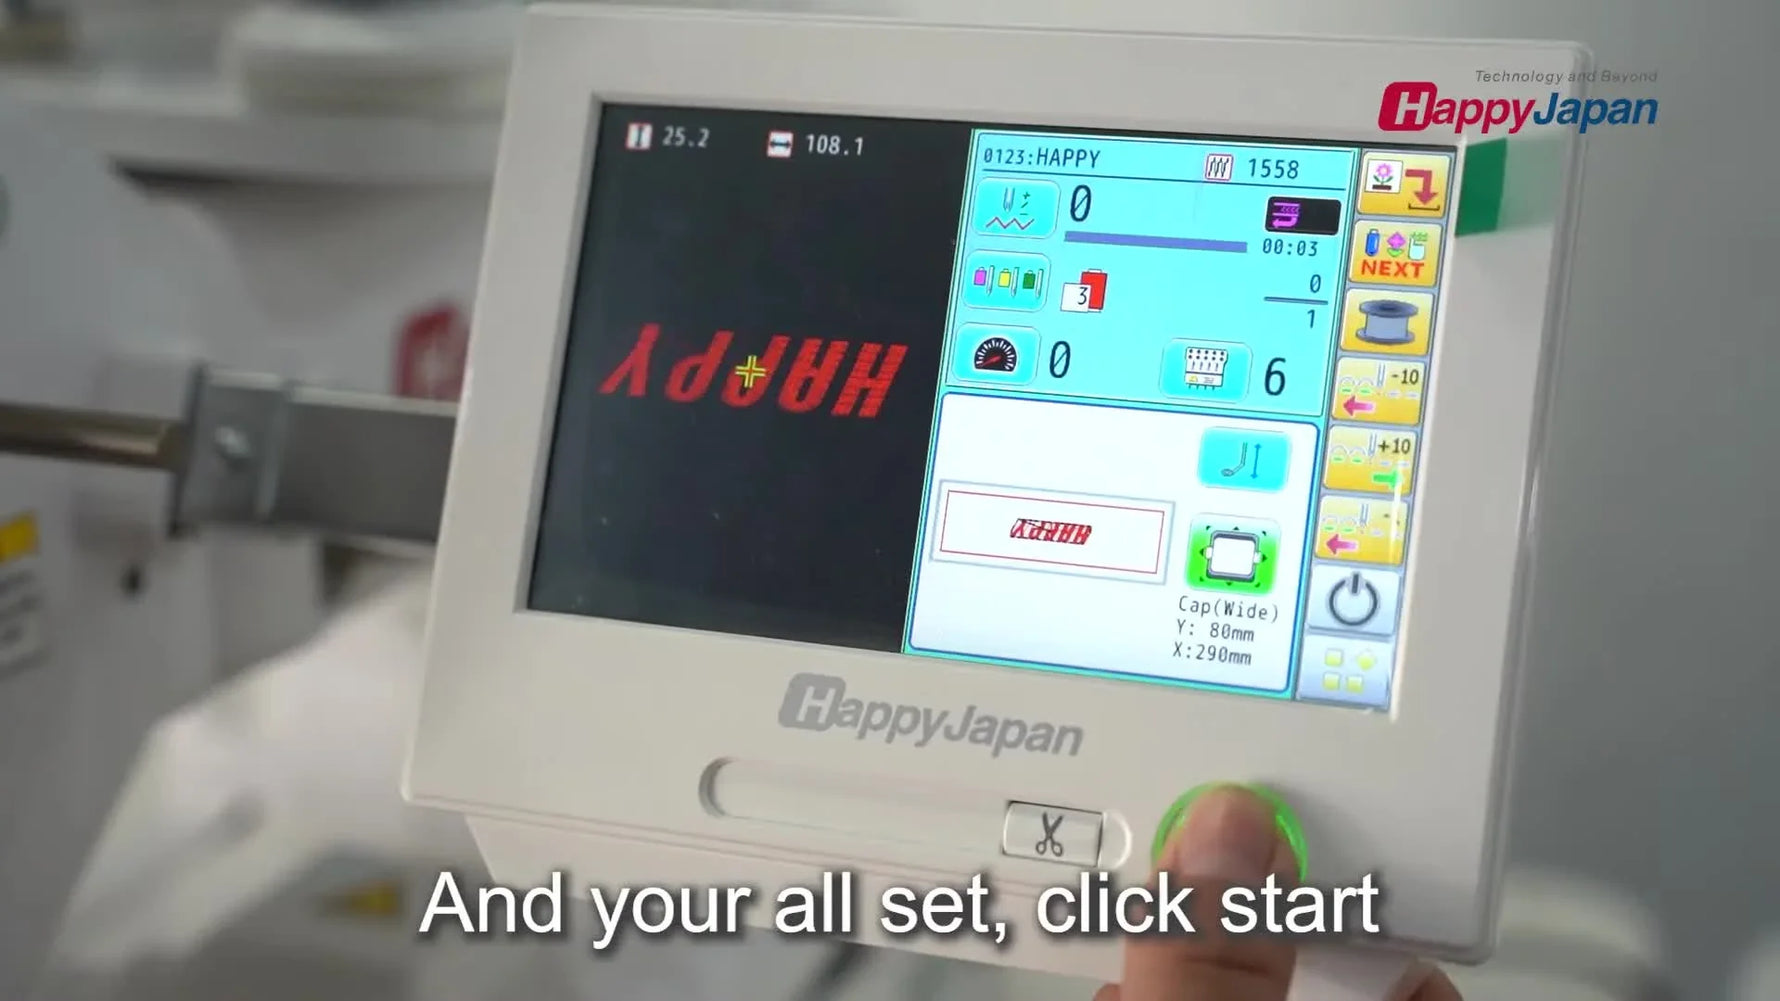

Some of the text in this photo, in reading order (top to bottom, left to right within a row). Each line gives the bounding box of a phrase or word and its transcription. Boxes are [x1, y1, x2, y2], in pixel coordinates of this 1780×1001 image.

[662, 125, 710, 148] 25.2
[805, 133, 865, 156] 108.1
[982, 147, 1101, 169] 0123:HAPPY
[1247, 157, 1300, 179] 1558
[1069, 184, 1093, 223] 0
[1261, 238, 1319, 257] 00:03
[1360, 259, 1425, 280] NEXT
[1309, 273, 1322, 294] 0
[1077, 285, 1088, 306] 3
[1307, 308, 1316, 329] 1
[1048, 340, 1072, 379] 0
[1263, 356, 1287, 396] 6
[1391, 368, 1419, 386] -10
[1377, 437, 1411, 455] +10
[1178, 595, 1279, 624] Cap(Wide)
[1177, 618, 1255, 642] Y: 80mm
[1172, 641, 1252, 666] X:290mm
[778, 672, 1085, 758] HappyJapan
